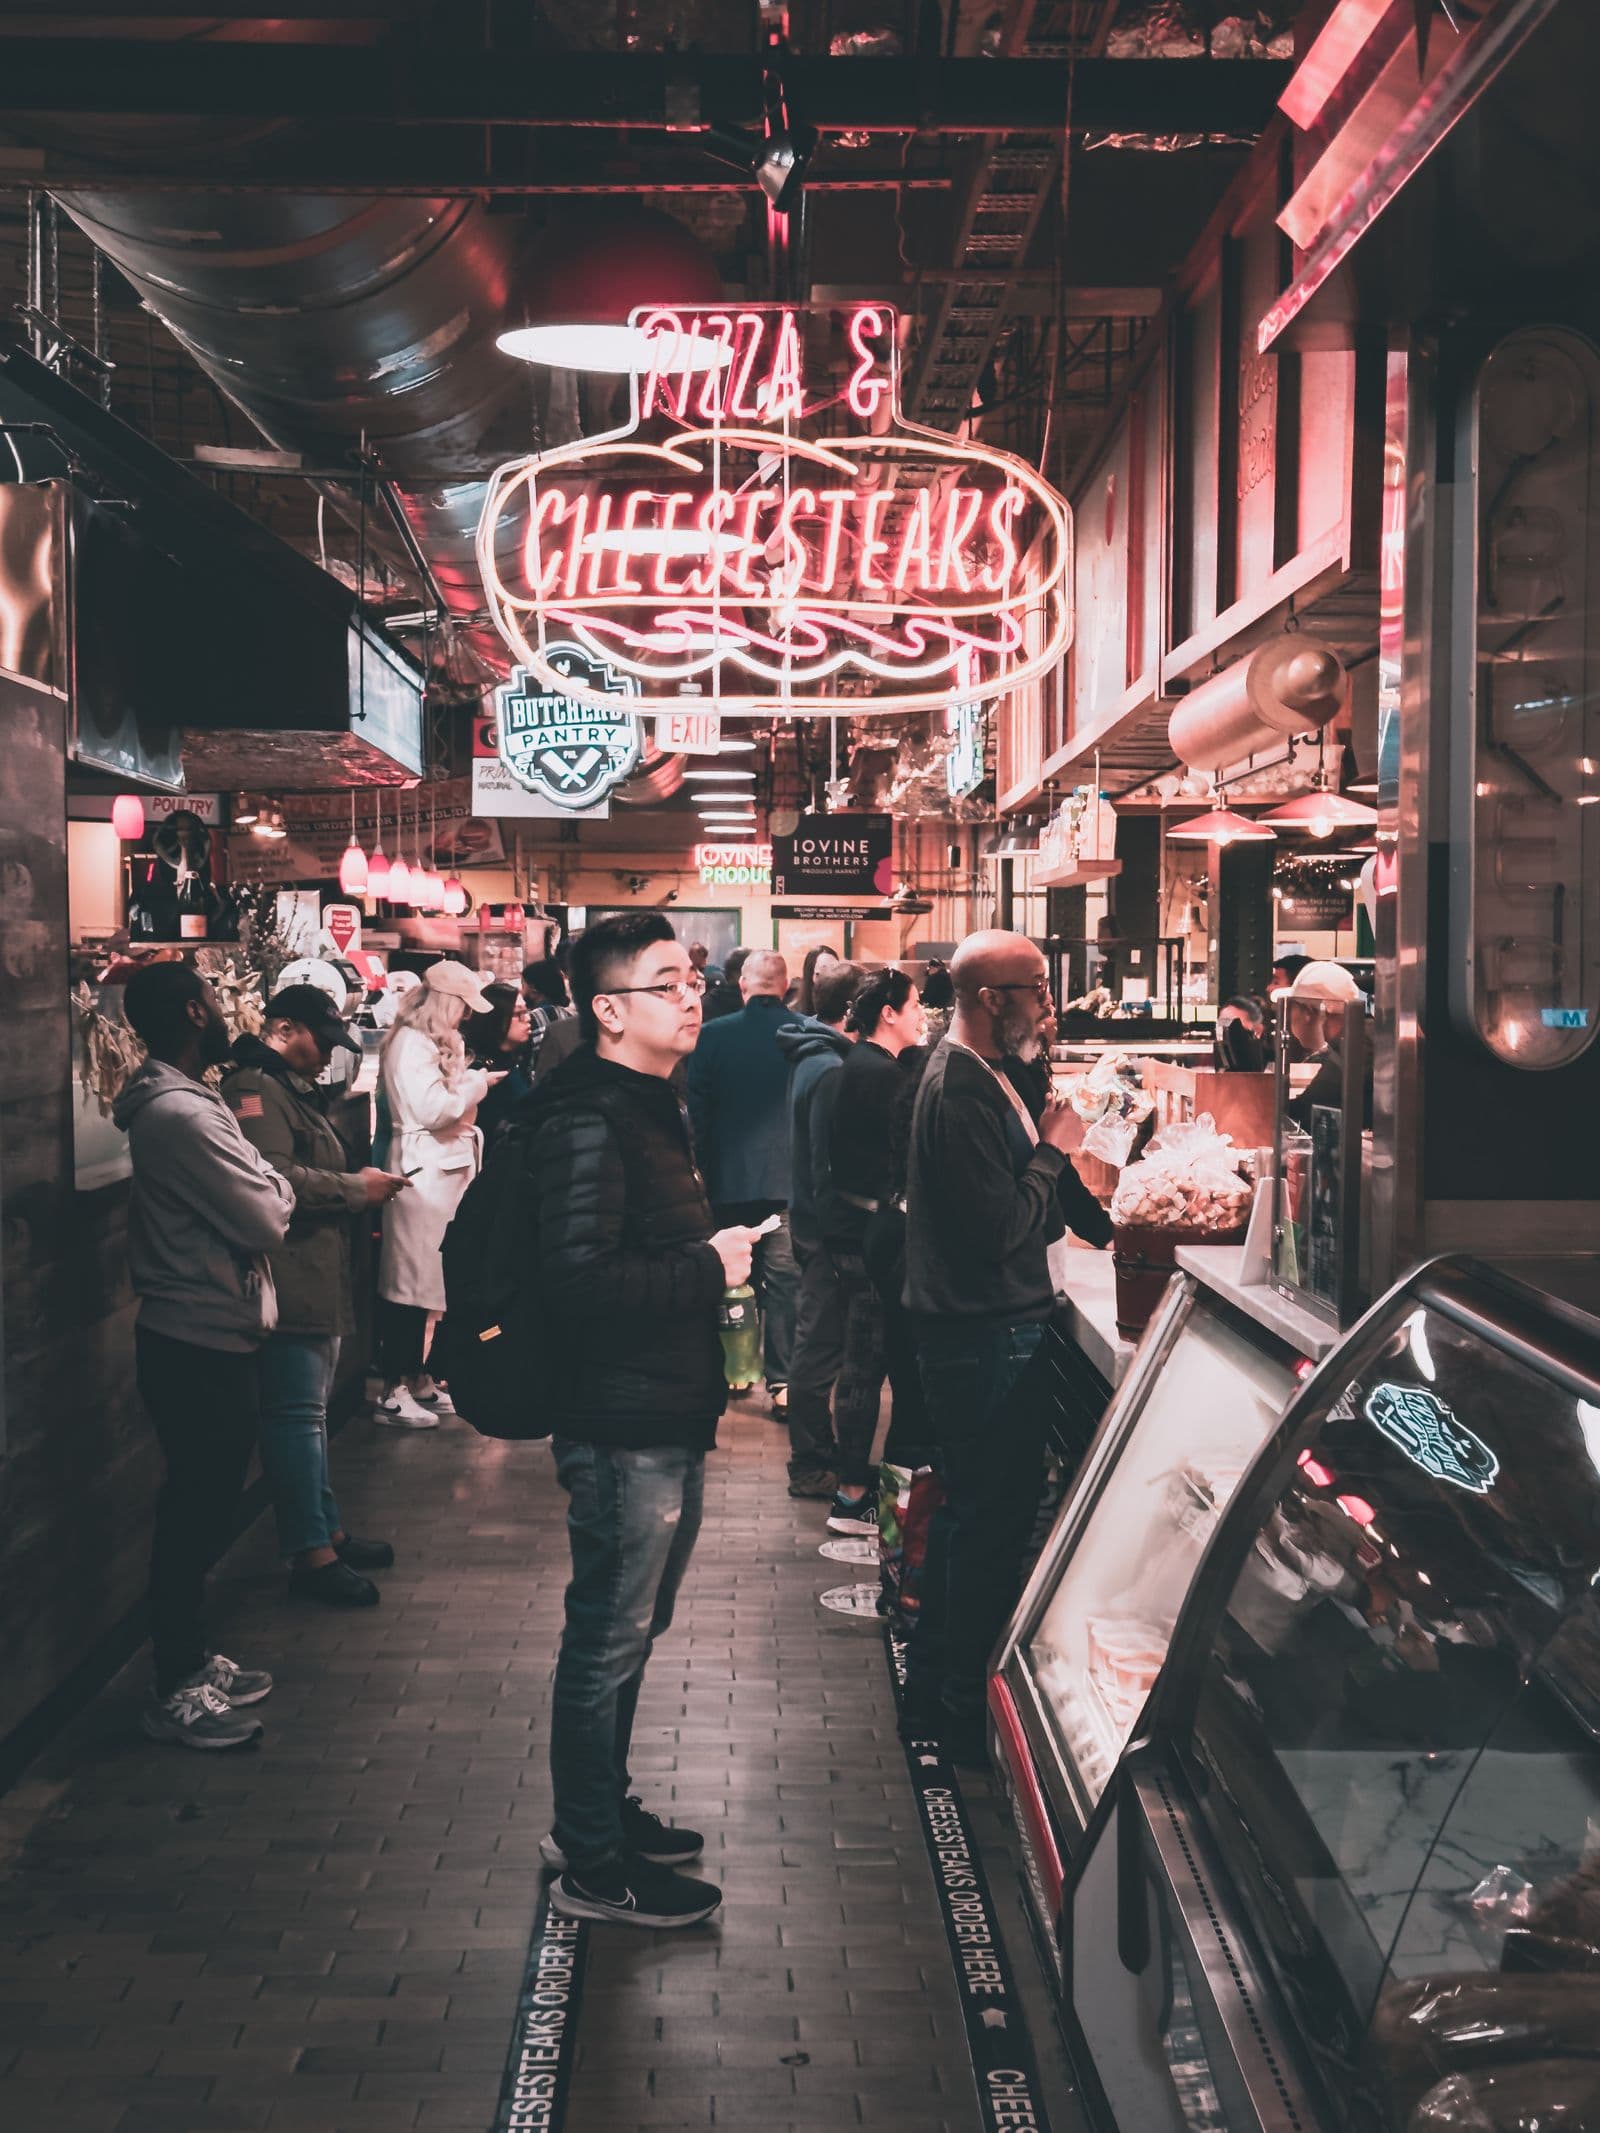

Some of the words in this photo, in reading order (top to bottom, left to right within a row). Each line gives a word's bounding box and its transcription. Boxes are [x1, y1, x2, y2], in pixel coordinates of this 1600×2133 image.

[642, 311, 802, 419] PIZZA
[849, 307, 890, 417] &
[525, 487, 1026, 597] CHEESESTEAKS
[522, 728, 617, 748] PANTRY
[152, 797, 214, 815] POULTRY
[695, 844, 772, 866] IOVINE
[793, 839, 869, 854] IOVINE
[793, 856, 869, 866] BROTHERS
[700, 865, 772, 885] PRODUC
[923, 1787, 977, 1887] CHEESESTEAKS
[543, 1903, 579, 1942] HE
[948, 1891, 993, 1945] ORDER
[532, 1944, 577, 2006] ORDER
[960, 1948, 1006, 1996] HERE
